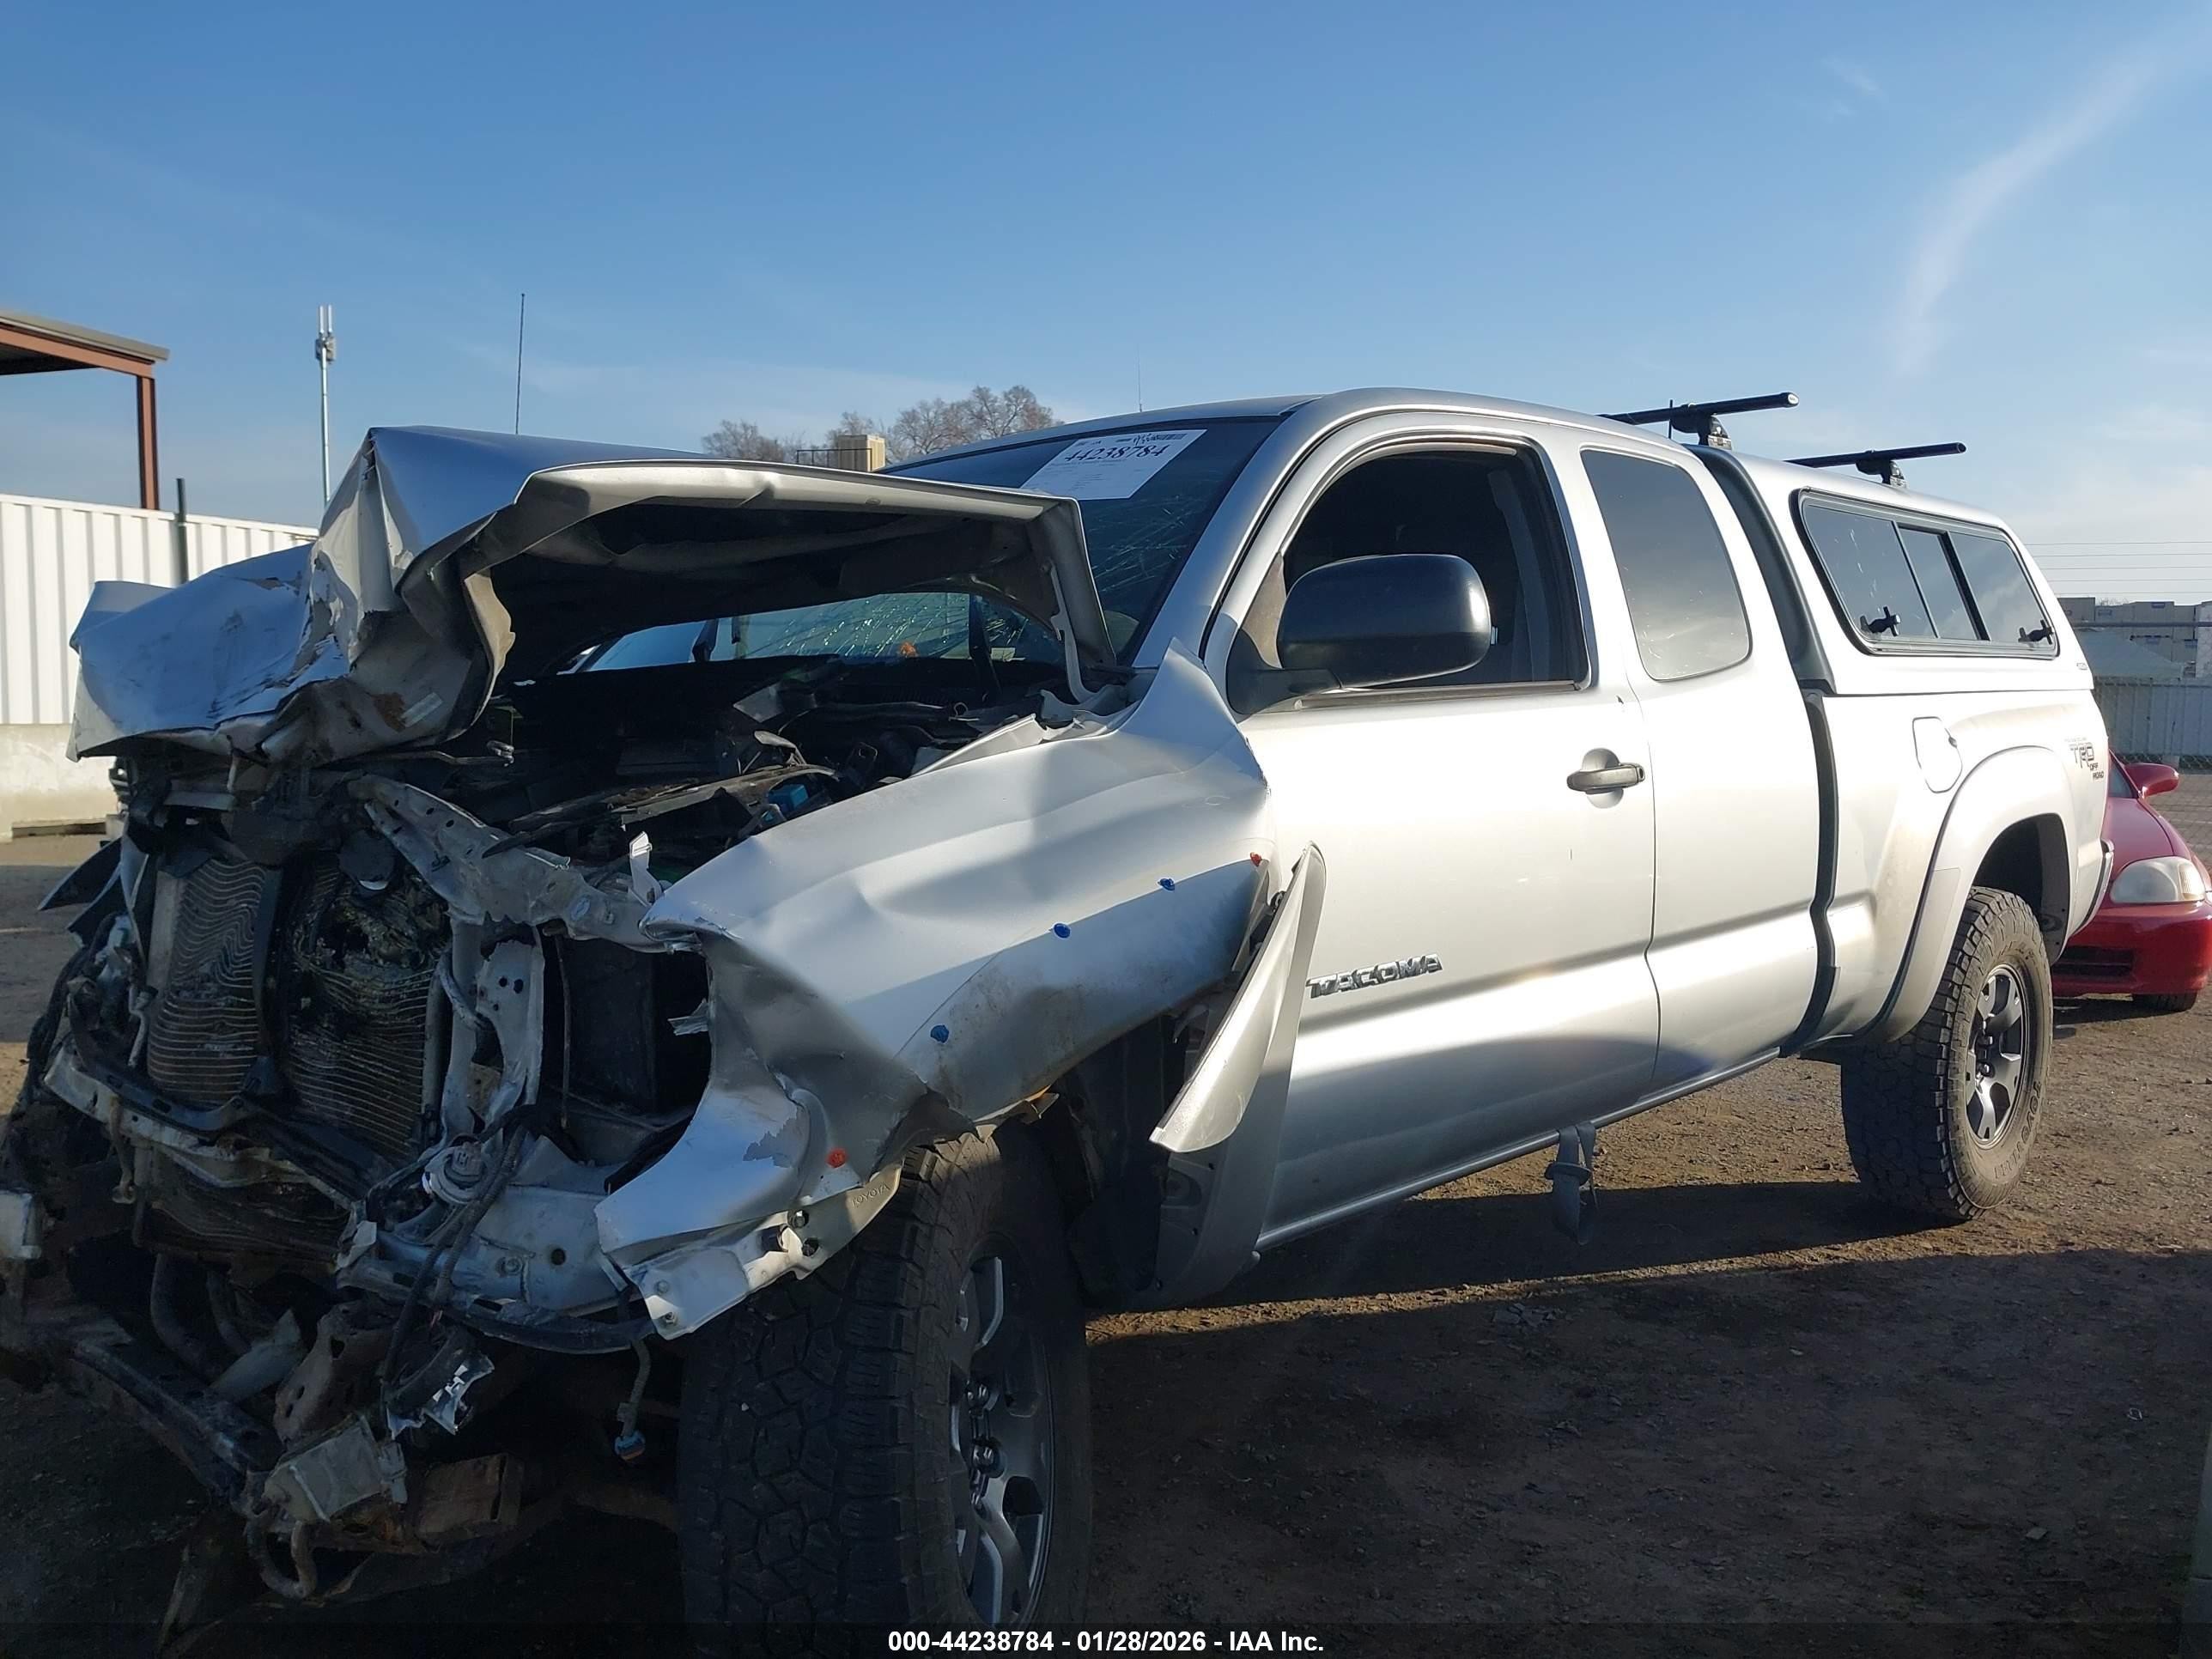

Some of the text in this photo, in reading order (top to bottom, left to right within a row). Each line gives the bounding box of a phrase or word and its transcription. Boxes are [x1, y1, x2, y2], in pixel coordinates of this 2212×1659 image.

[1065, 444, 1170, 461] 44238784
[2069, 742, 2095, 769] TRD
[1305, 953, 1443, 999] TACOMA
[851, 1182, 890, 1207] TOYOTA
